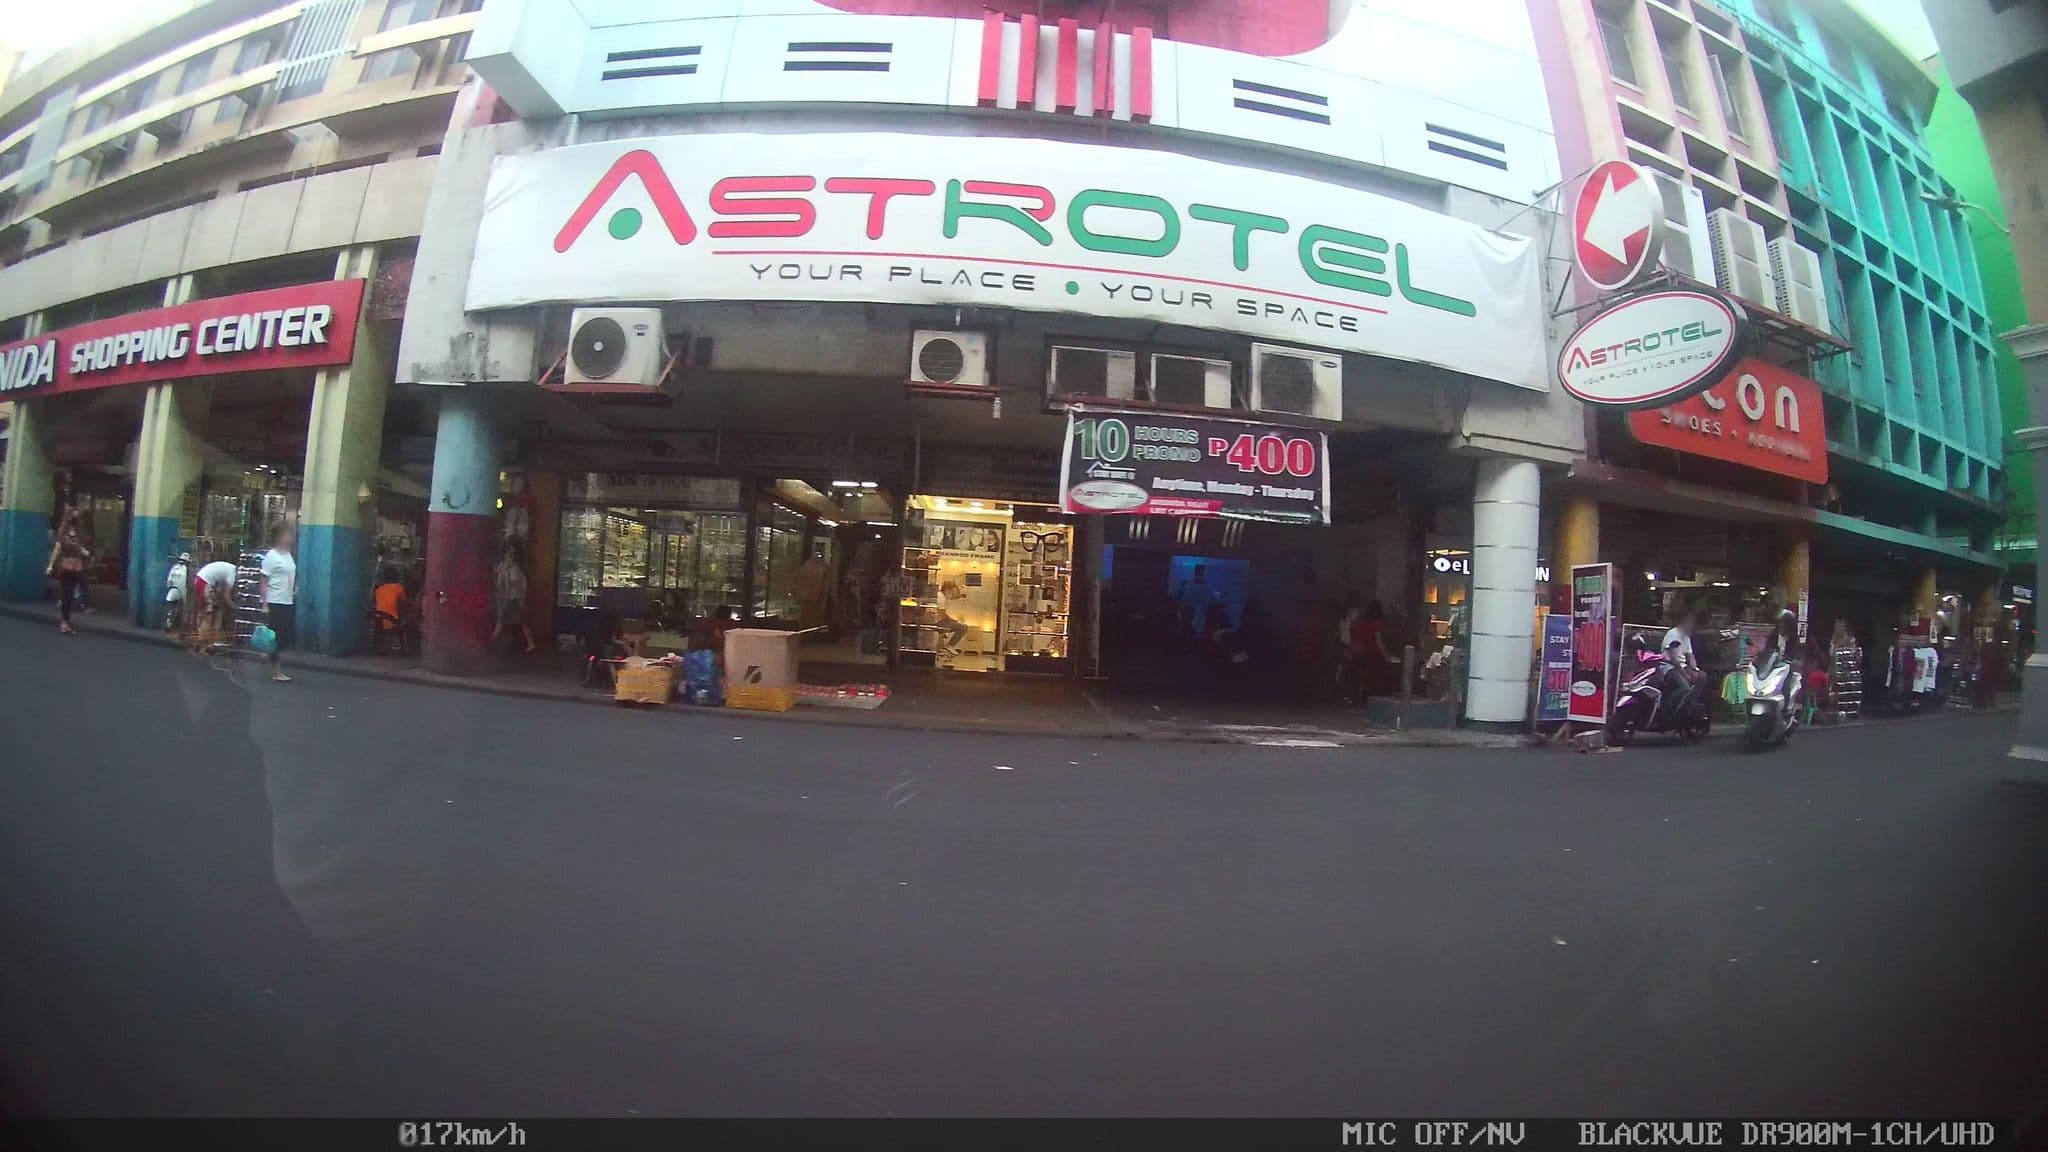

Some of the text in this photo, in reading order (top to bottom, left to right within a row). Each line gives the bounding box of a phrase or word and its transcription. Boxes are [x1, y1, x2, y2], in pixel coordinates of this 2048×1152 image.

[554, 149, 1476, 318] ASTROTEL
[751, 263, 1359, 334] YOUR PLACE YOUR SPACE
[69, 323, 191, 374] SHOPPING
[196, 304, 332, 355] CENTER
[1567, 320, 1722, 374] ASTROTEL
[1680, 350, 1714, 363] SPACE
[1074, 419, 1130, 462] 10
[1134, 425, 1199, 444] HOURS
[1660, 408, 1722, 437] SOES
[1133, 444, 1201, 463] PROMO
[1550, 636, 1570, 644] STAY
